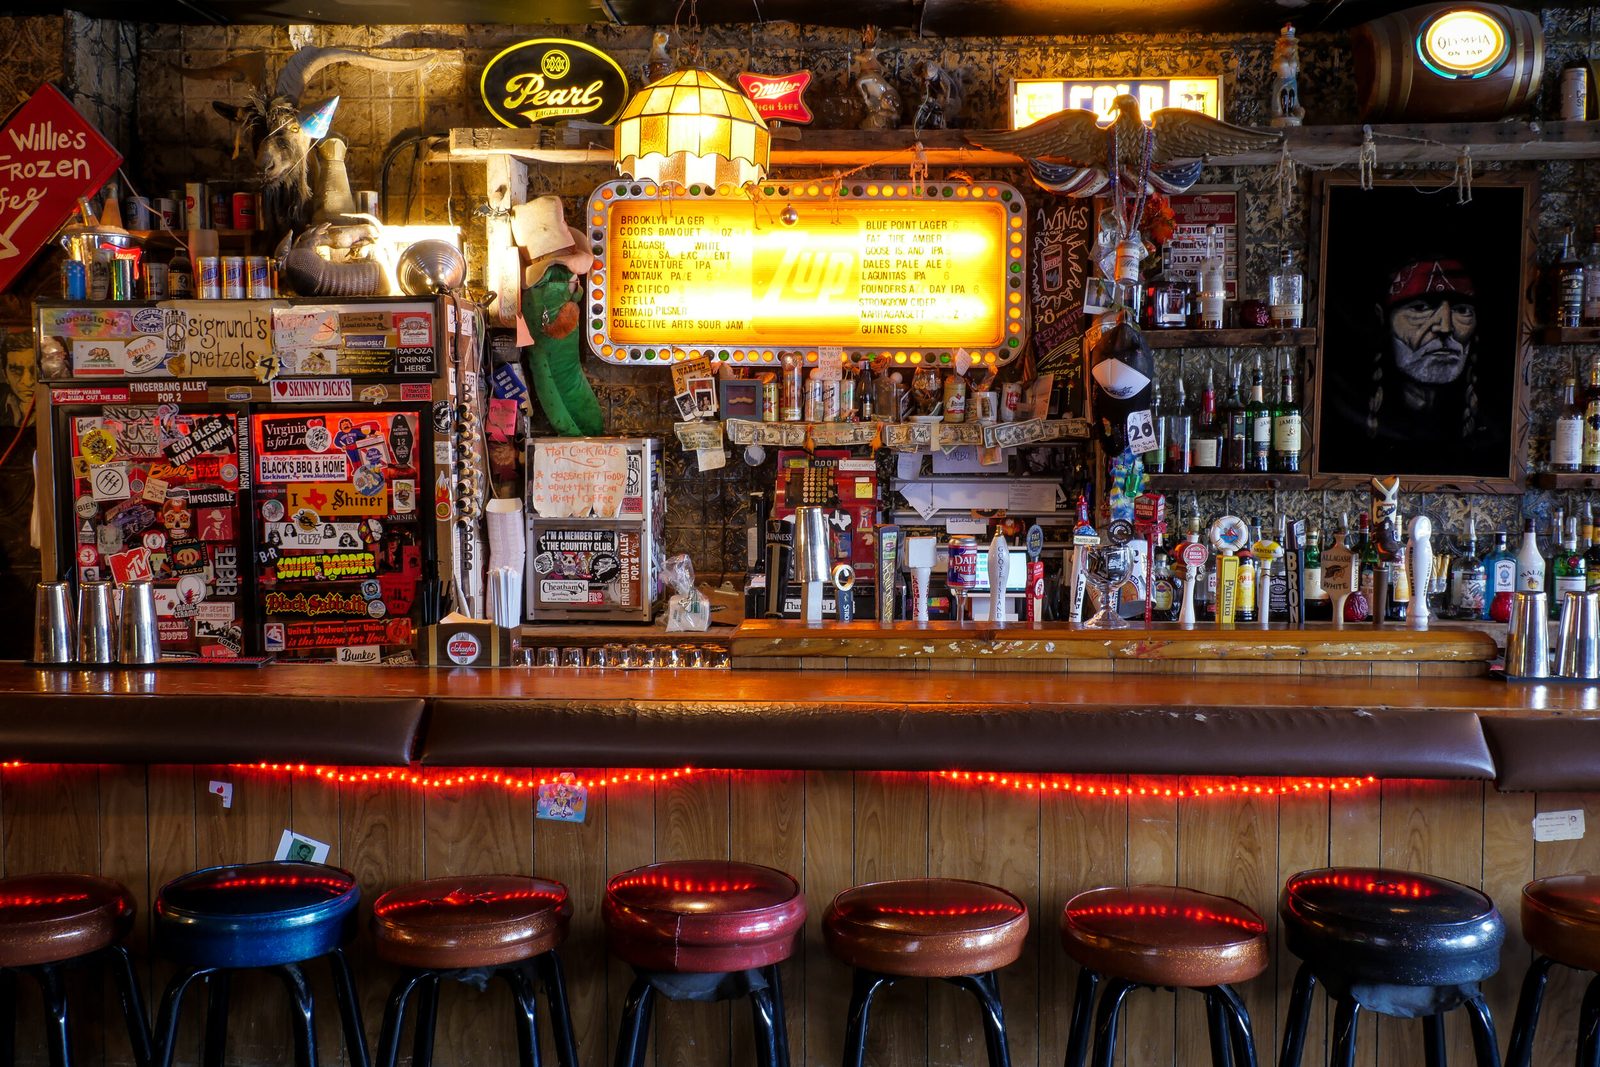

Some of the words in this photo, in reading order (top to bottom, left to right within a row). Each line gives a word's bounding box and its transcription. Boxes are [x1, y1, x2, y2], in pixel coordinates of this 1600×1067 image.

[1437, 34, 1491, 49] OLYMPIA
[503, 73, 603, 109] Pearl
[750, 81, 800, 99] Miller
[621, 216, 667, 225] BROOKLYN
[675, 216, 704, 225] LAGER
[866, 221, 887, 230] BLUE
[891, 221, 916, 230] POINT
[919, 221, 947, 230] LAGER
[1036, 207, 1089, 231] WINES
[620, 227, 653, 236] COORS
[659, 227, 700, 236] BANQUET
[630, 260, 683, 269] ADVENTURE
[696, 261, 711, 269] IPA
[863, 260, 890, 269] DALES
[896, 260, 918, 269] PALE
[926, 260, 942, 269] ALE
[622, 272, 663, 280] MONTAUK
[862, 272, 906, 280] LAGUNITAS
[914, 271, 926, 280] IPA
[624, 285, 670, 294] PACIFICO
[861, 285, 906, 294] FOUNDERS
[930, 285, 946, 294] DAY
[951, 285, 965, 294] IPA
[621, 297, 655, 305] STELLA
[613, 307, 653, 317] MERMAID
[613, 319, 666, 328] COLLECTIVE
[672, 321, 694, 329] ARTS
[698, 321, 721, 329] SOUR
[726, 321, 743, 330] JAM
[861, 325, 907, 334] GUINNESS
[190, 342, 255, 375] pretzels
[260, 357, 275, 380] 4
[676, 361, 706, 376] WANTED
[130, 382, 181, 392] FINGERBANG
[182, 381, 208, 391] ALLEY
[272, 382, 276, 396] I
[289, 381, 321, 396] SKINNY
[323, 380, 350, 396] DICK'S
[157, 393, 174, 402] POP.
[176, 392, 182, 401] 2
[238, 417, 248, 436] THANK
[264, 422, 307, 436] Virginia
[172, 436, 192, 454] GOD
[193, 419, 222, 442] BLESS
[239, 437, 248, 449] YOU
[267, 437, 274, 447] is
[273, 435, 289, 450] for
[172, 445, 201, 467] VINYL
[200, 428, 234, 453] RANCH
[239, 450, 249, 472] JOHNNY
[262, 461, 295, 474] BLACK'S
[296, 462, 312, 475] BBQ
[315, 463, 321, 473] &
[322, 462, 345, 473] HOME
[239, 472, 250, 490] CASH
[291, 493, 298, 507] I
[331, 488, 383, 511] Shiner
[77, 502, 98, 513] BIEN
[298, 533, 322, 544] KISS
[546, 531, 557, 540] I'M
[558, 532, 563, 540] A
[564, 532, 593, 541] MEMBER
[594, 532, 603, 540] OF
[546, 542, 559, 551] THE
[560, 541, 593, 551] COUNTRY
[594, 541, 614, 551] CLUB.
[620, 532, 629, 556] ALLEY
[276, 556, 317, 580] SOUTH
[322, 553, 377, 576] BORDER
[631, 563, 640, 581] POP.
[621, 556, 630, 606] FINGERBANG
[1323, 582, 1348, 590] WHITE
[1076, 580, 1084, 610] POINT
[1225, 579, 1235, 617] PACIFICO
[266, 592, 308, 615] Black
[307, 592, 368, 616] Sabbath
[288, 638, 297, 646] is
[298, 636, 314, 645] the
[316, 636, 346, 645] Union
[349, 634, 365, 644] for
[341, 648, 377, 662] Bunker
